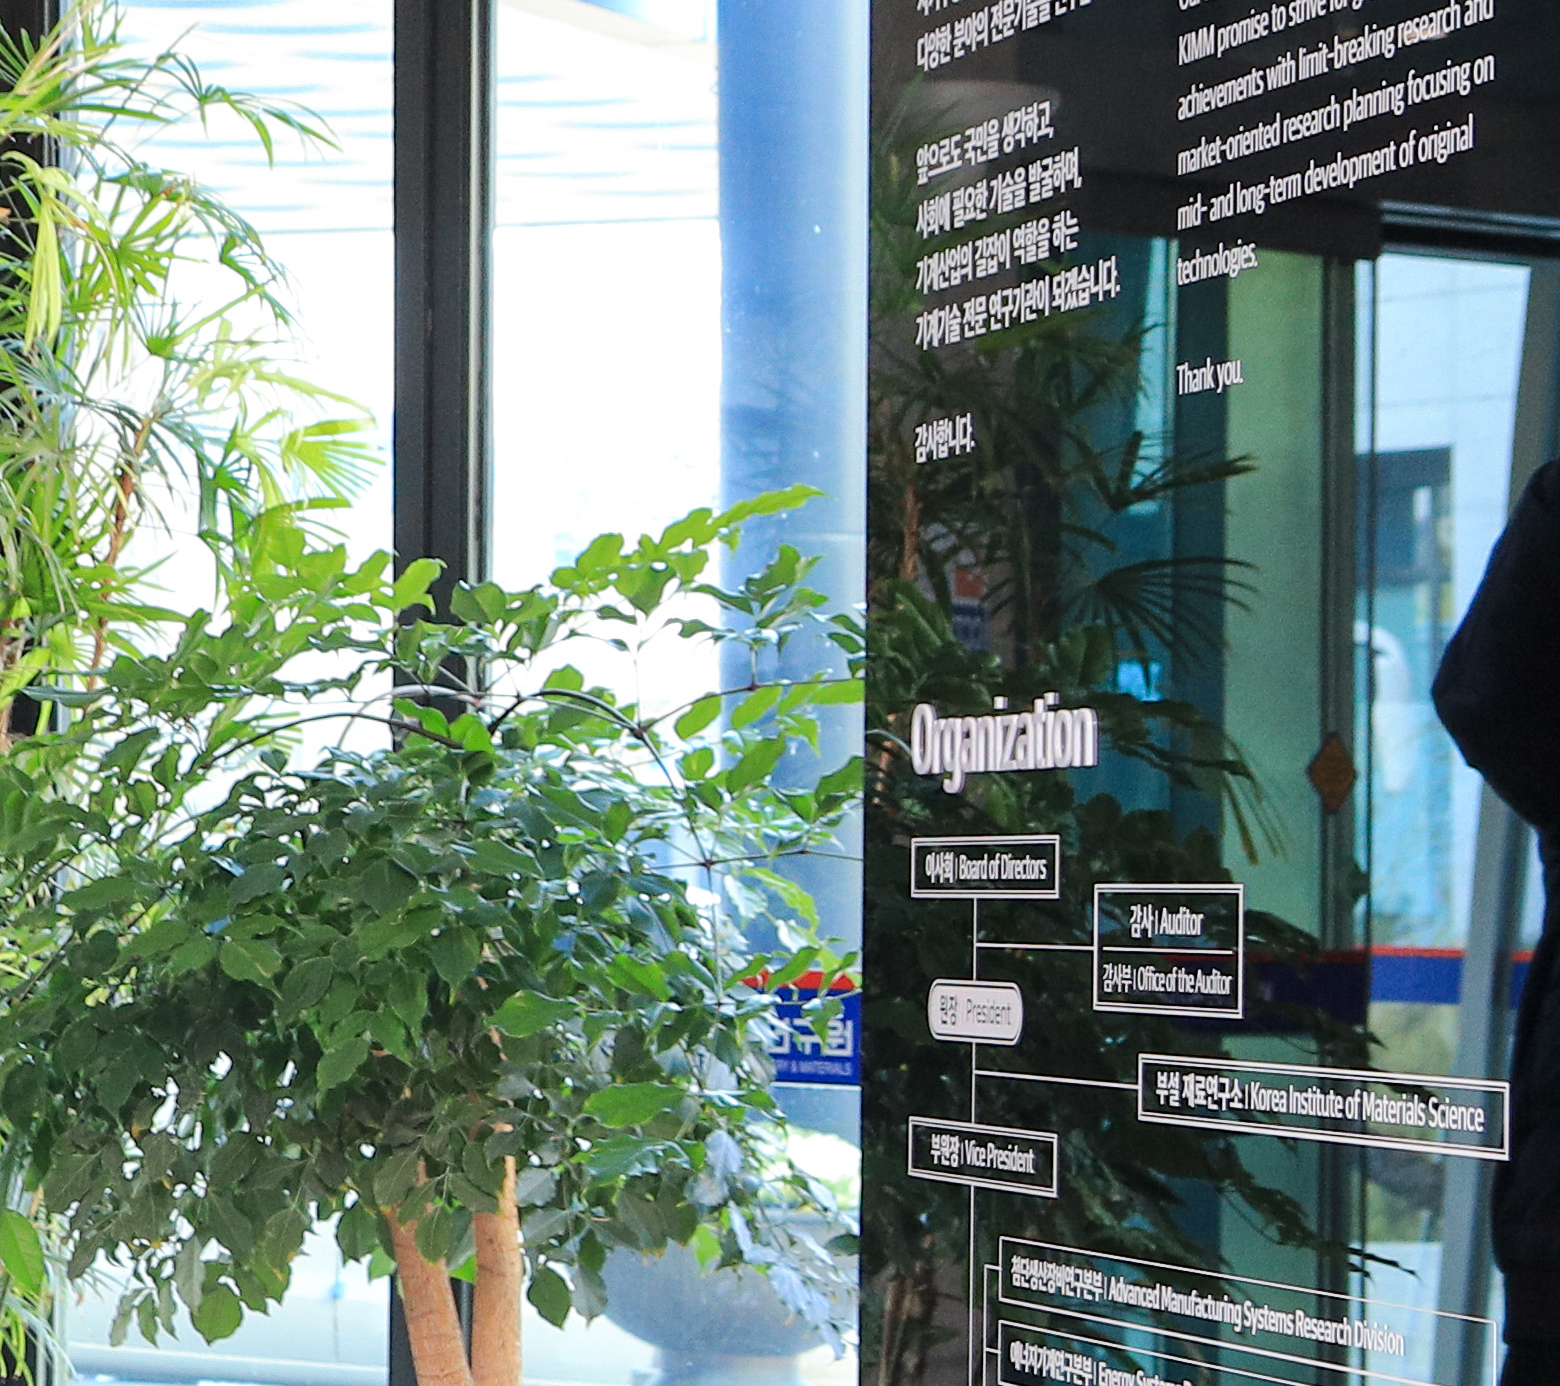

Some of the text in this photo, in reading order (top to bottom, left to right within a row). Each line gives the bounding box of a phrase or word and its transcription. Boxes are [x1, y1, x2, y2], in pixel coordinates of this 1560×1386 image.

[1177, 67, 1265, 121] achievements
[1265, 51, 1297, 91] with
[1298, 23, 1396, 81] limit-breaking
[1177, 54, 1495, 176] market-oriented research planning focusing on
[915, 100, 1055, 186] 앞으로도 국민을 생각하고,
[1176, 238, 1259, 286] technologies.
[1175, 356, 1244, 396] Thank you.
[914, 412, 976, 464] 감사합니다.
[910, 690, 1100, 794] Organization
[924, 851, 1048, 884] 이사회 Board of Directors
[1129, 903, 1205, 939] 감사 Auditor
[1102, 962, 1234, 995] 감사부 Office of the Auditor
[1155, 1070, 1485, 1133] 부설 재료연구소 Korea Institute of Materials Science
[929, 1133, 1036, 1174] 부원장 Vice President
[1107, 1275, 1161, 1310] Advanced
[1160, 1285, 1243, 1333] Manufacturing
[1242, 1299, 1295, 1336] Systems
[1294, 1309, 1353, 1346] Research
[1353, 1317, 1405, 1358] Division
